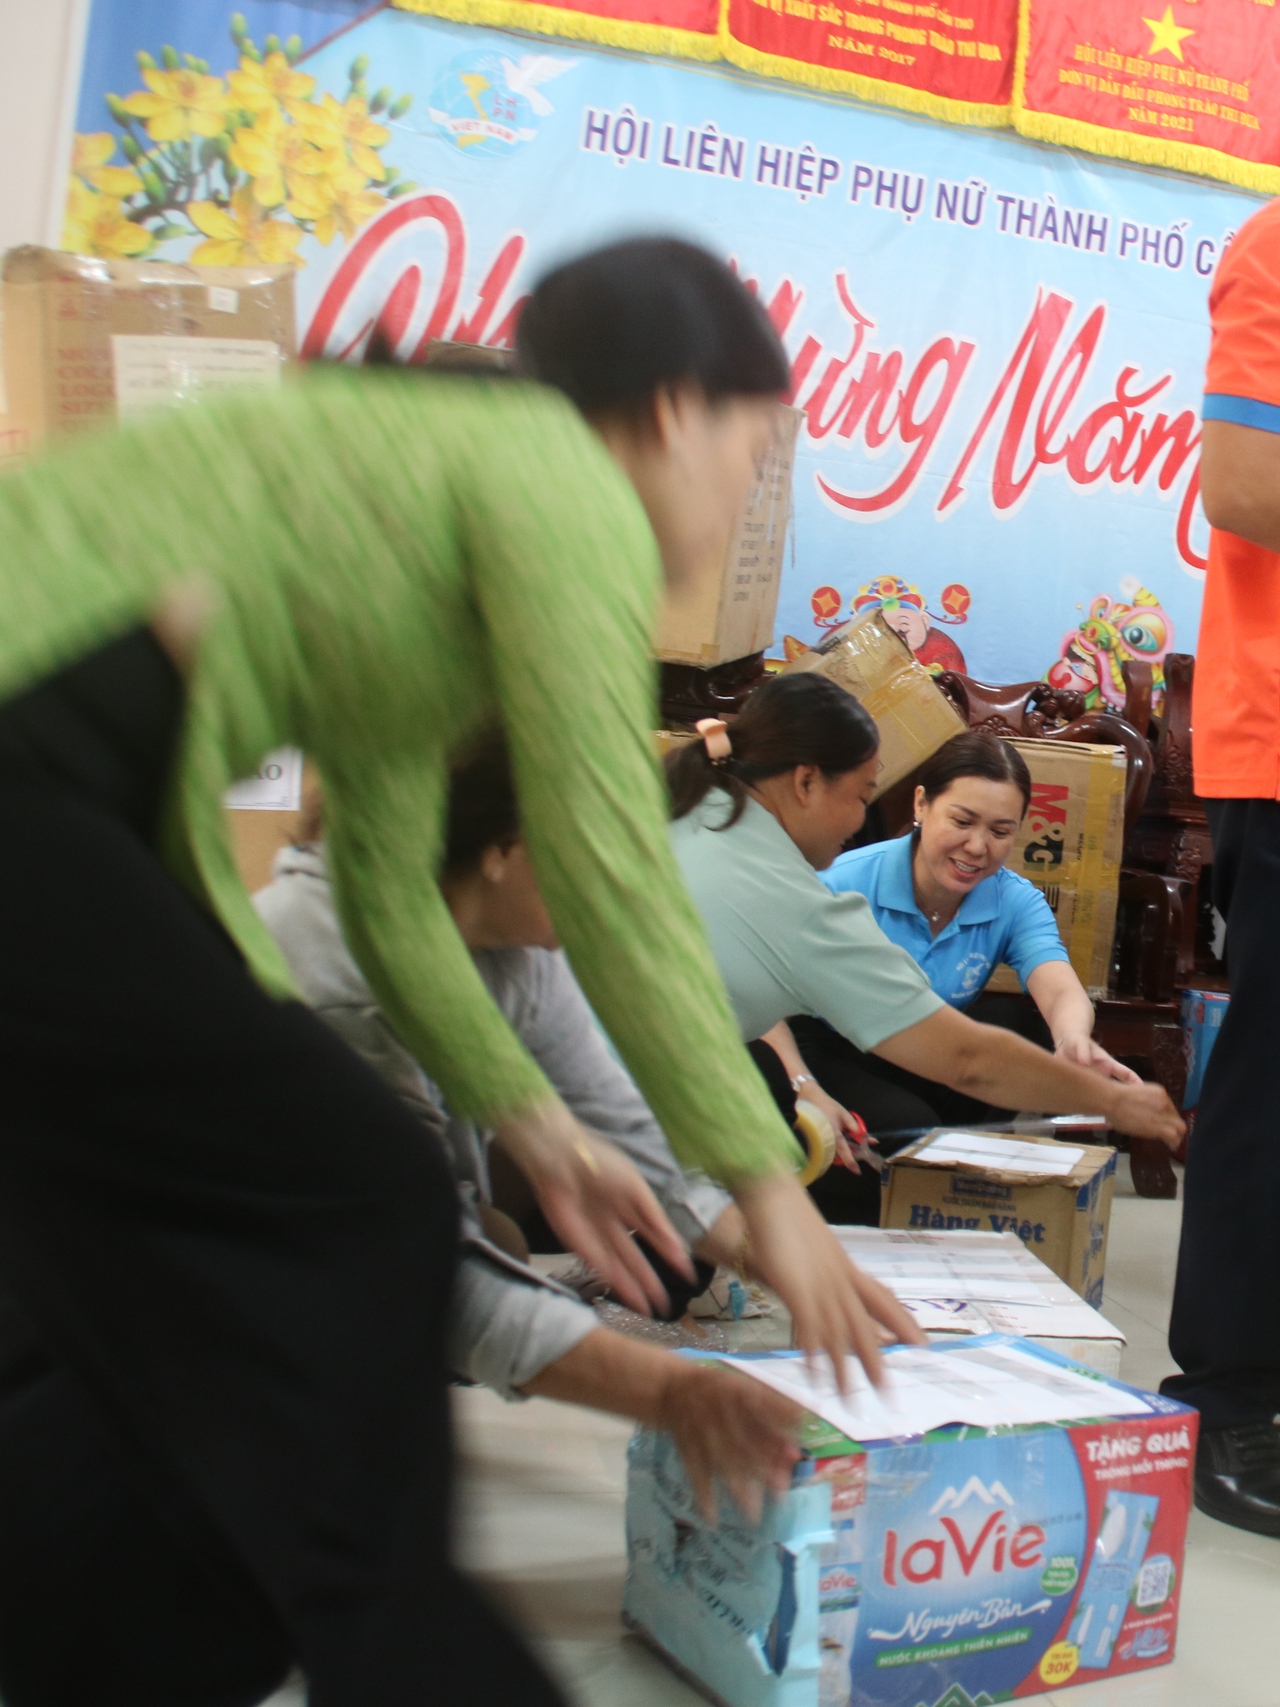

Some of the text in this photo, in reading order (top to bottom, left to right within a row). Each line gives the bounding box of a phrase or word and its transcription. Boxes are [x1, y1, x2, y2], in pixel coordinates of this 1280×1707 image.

[828, 34, 916, 66] NĂM 2017
[1148, 88, 1187, 109] PHONG
[1129, 105, 1194, 132] NĂM 2021
[584, 107, 650, 165] HỘI
[662, 124, 745, 178] LIÊN
[757, 145, 840, 201] HIỆP
[850, 164, 924, 222] PHỤ
[935, 180, 987, 227] NỮ
[997, 193, 1109, 253] THÀNH
[1119, 219, 1192, 270] PHỐ
[909, 1205, 1047, 1243] Hàng Việt
[1086, 1424, 1191, 1466] TẶNG QUÀ
[882, 1510, 1047, 1587] laVie
[880, 1607, 983, 1643] Nguyên
[1045, 1661, 1072, 1675] 30K
